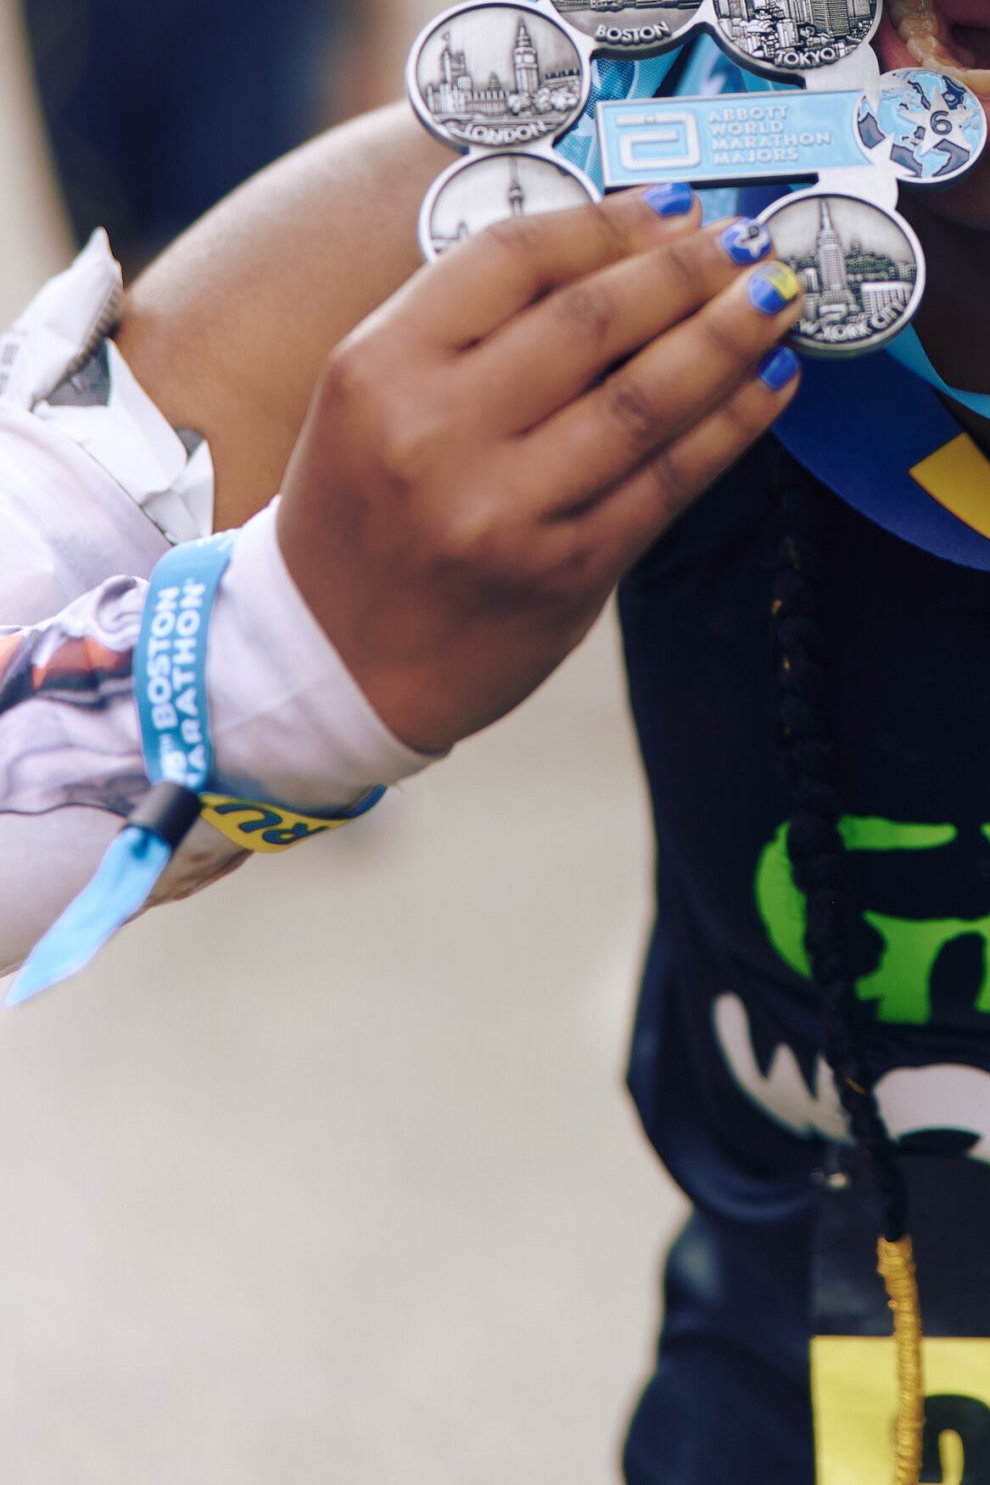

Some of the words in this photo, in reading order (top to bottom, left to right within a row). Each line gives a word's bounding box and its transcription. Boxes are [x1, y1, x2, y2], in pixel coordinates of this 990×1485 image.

[594, 20, 672, 47] BOSTON
[774, 47, 836, 69] TOKYO
[708, 104, 790, 124] ABBOTT
[930, 110, 953, 136] 6
[463, 119, 548, 146] LONDON
[709, 120, 786, 137] WORLD
[711, 131, 832, 153] MARATHON
[713, 147, 800, 167] MAJORS
[146, 586, 181, 730] BOSTON
